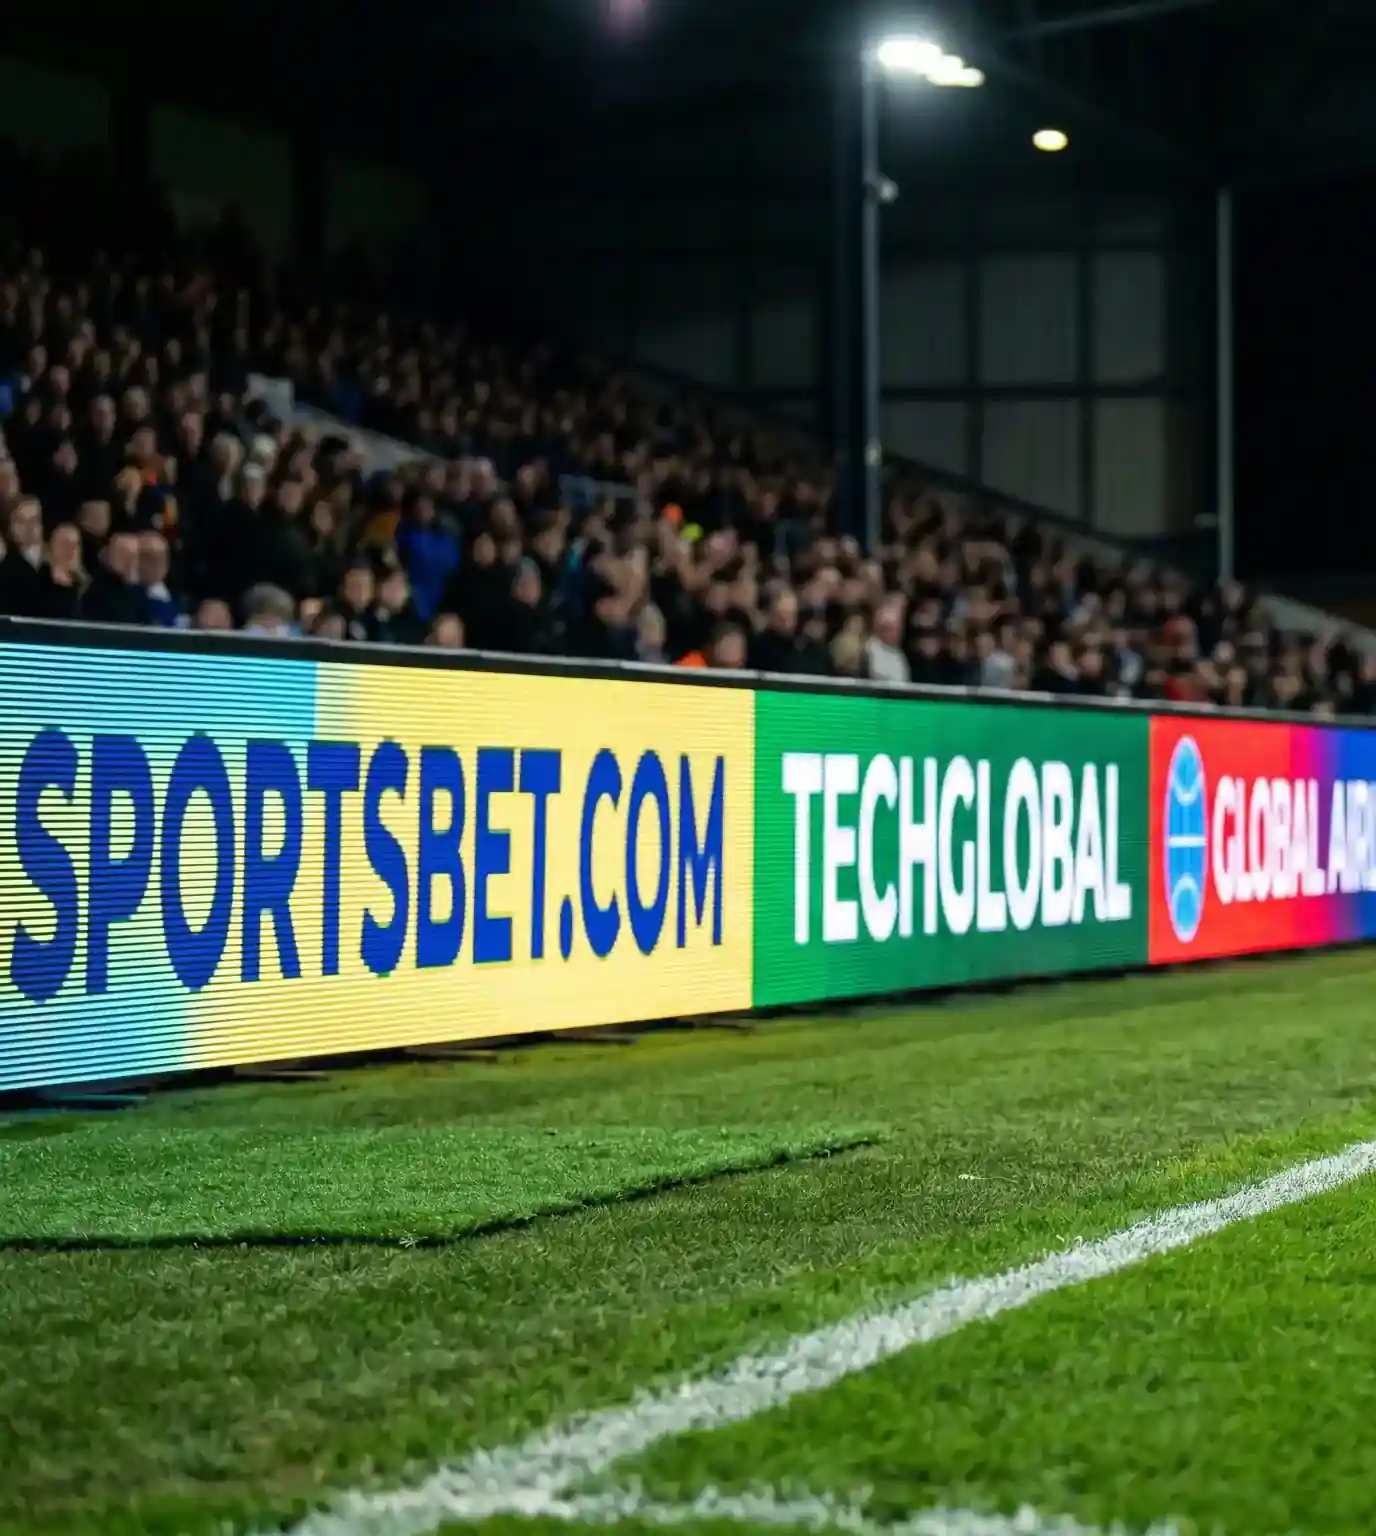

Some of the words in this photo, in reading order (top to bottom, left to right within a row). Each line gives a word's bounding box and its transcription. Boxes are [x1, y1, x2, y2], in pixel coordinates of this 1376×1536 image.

[9, 724, 725, 1004] SPORTSBET.COM
[781, 752, 1132, 944] TECHGLOBAL
[1212, 775, 1326, 905] GLOBAL
